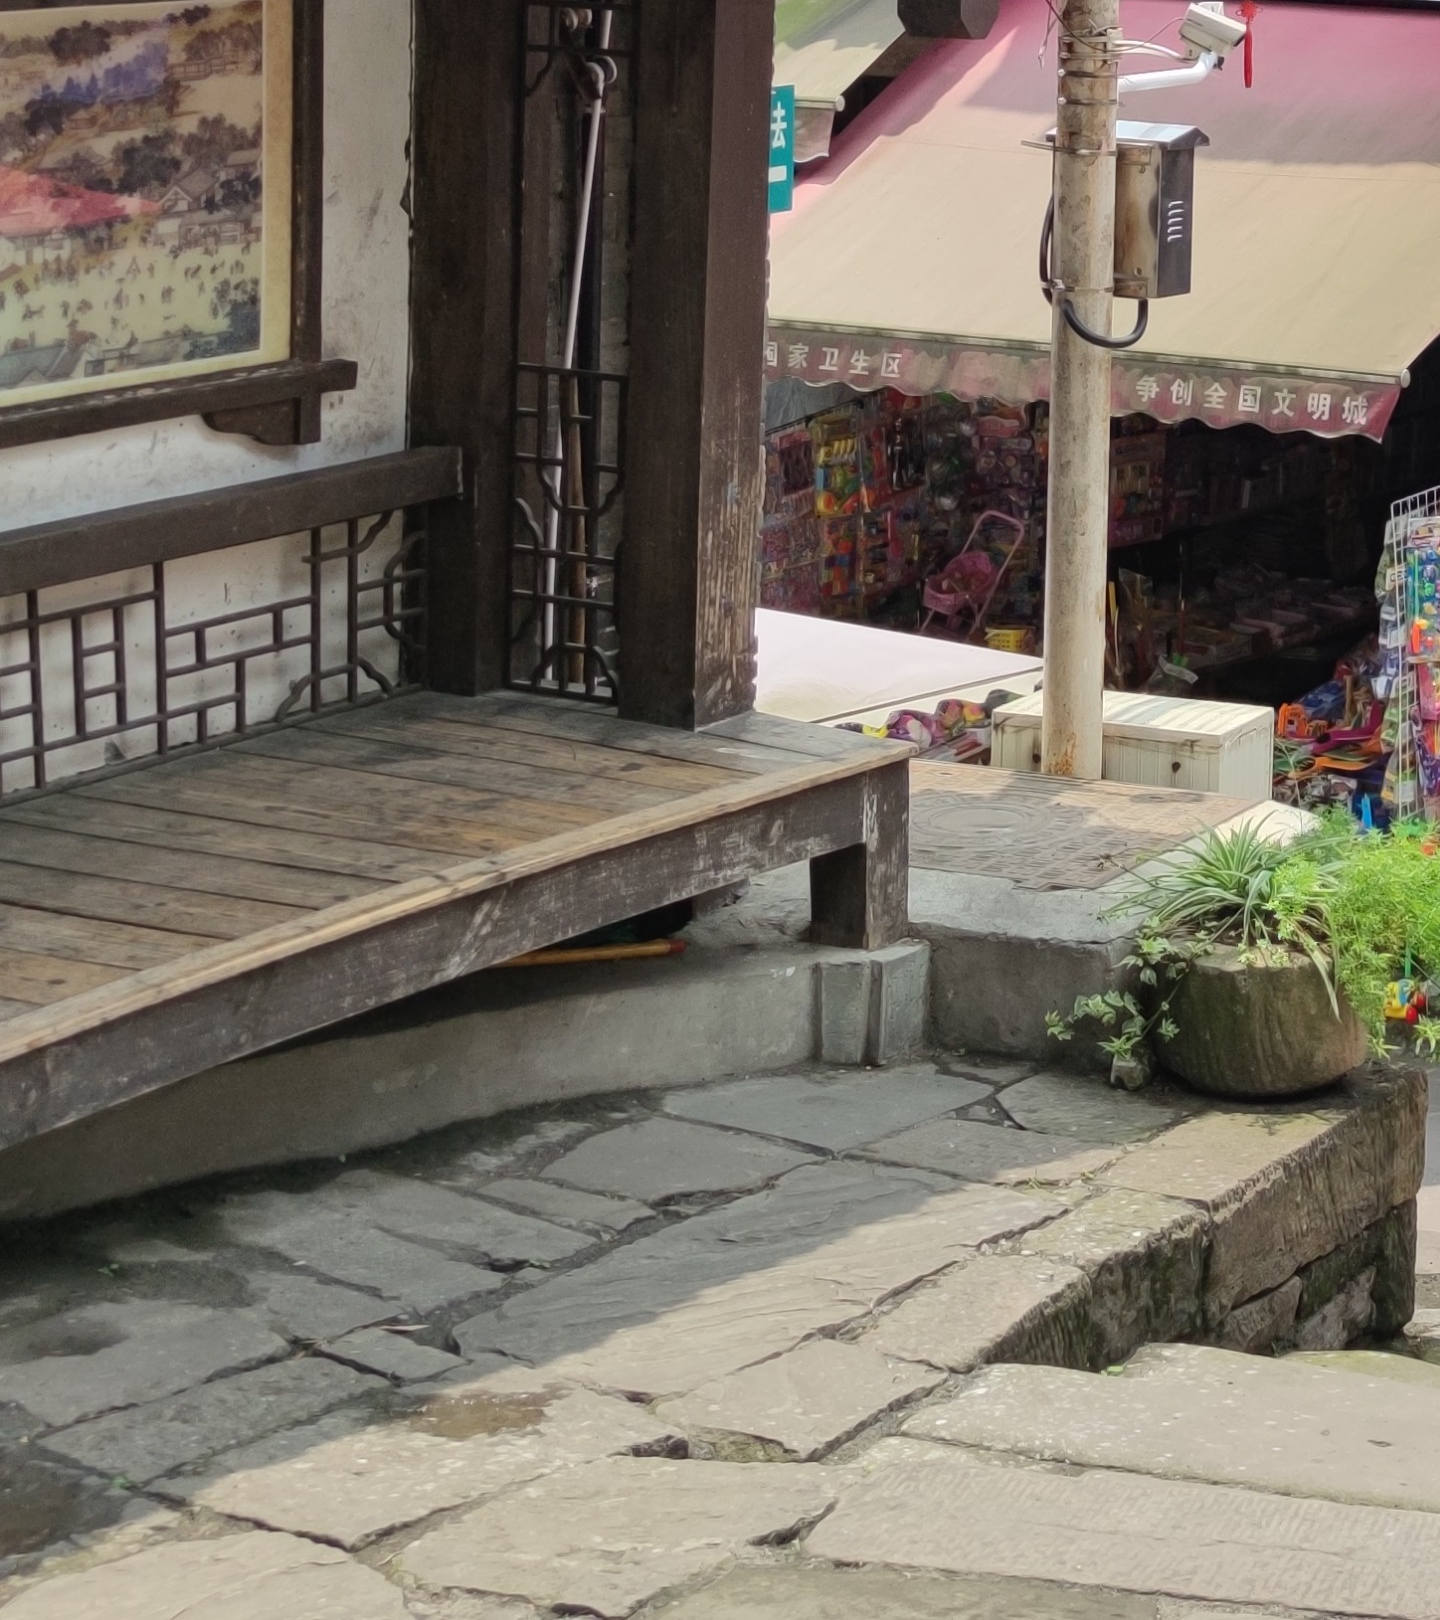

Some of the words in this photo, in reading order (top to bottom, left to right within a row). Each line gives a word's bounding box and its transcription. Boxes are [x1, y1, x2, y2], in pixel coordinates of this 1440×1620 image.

[1135, 374, 1368, 425] 争创全国文明城
